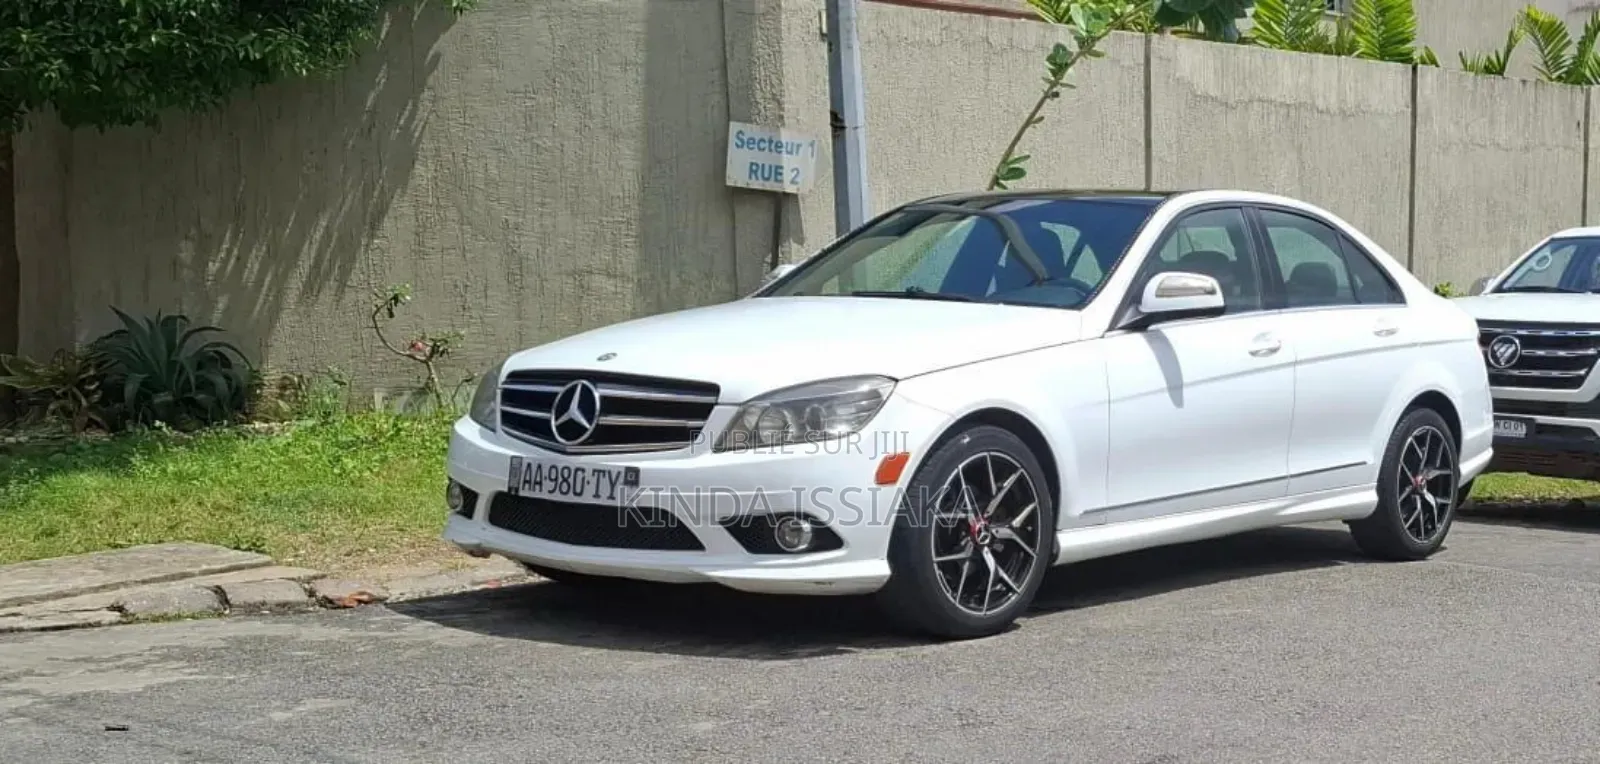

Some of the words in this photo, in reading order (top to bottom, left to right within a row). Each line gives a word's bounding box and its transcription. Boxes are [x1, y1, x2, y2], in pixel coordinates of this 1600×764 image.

[734, 130, 802, 156] Secteur
[808, 139, 816, 158] 1
[748, 161, 784, 183] RUE
[790, 167, 800, 185] 2
